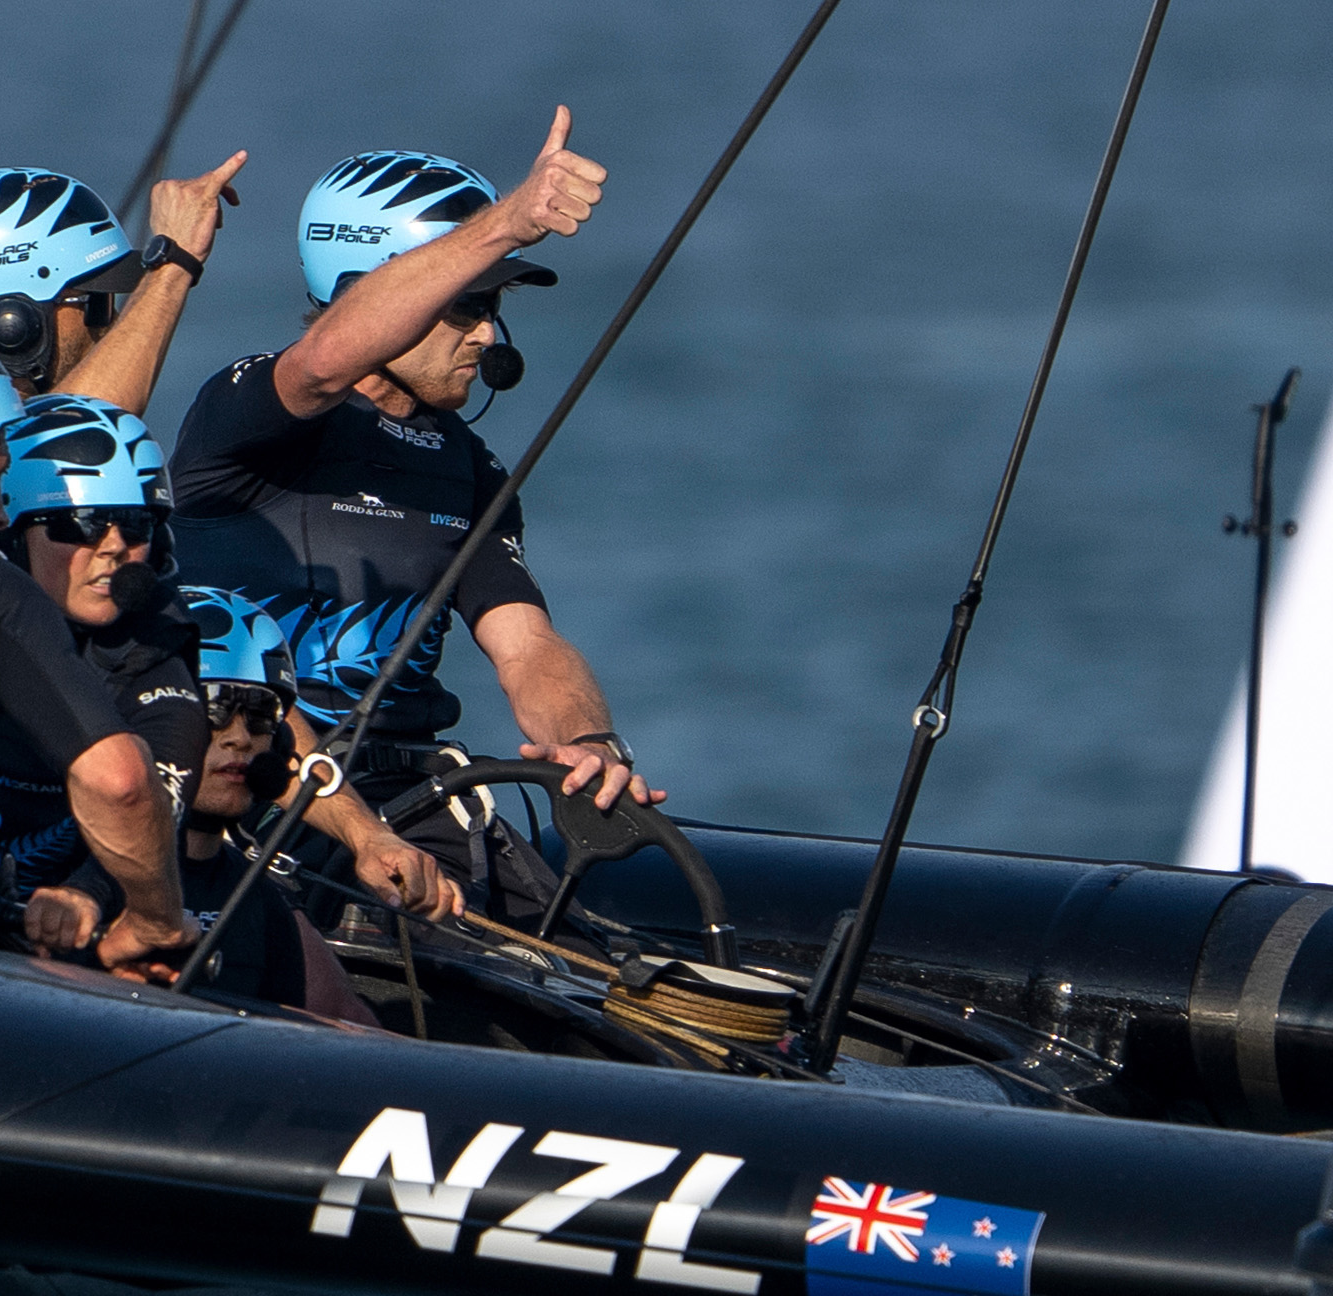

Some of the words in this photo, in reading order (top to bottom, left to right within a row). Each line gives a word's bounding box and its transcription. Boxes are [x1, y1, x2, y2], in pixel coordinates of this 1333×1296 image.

[337, 224, 393, 236] BLACK
[335, 233, 381, 244] FOILS
[404, 426, 445, 442] BLACK
[405, 436, 441, 450] FOILS
[332, 502, 365, 515] RODD
[138, 686, 200, 704] SAILG
[309, 1108, 762, 1296] NZL
